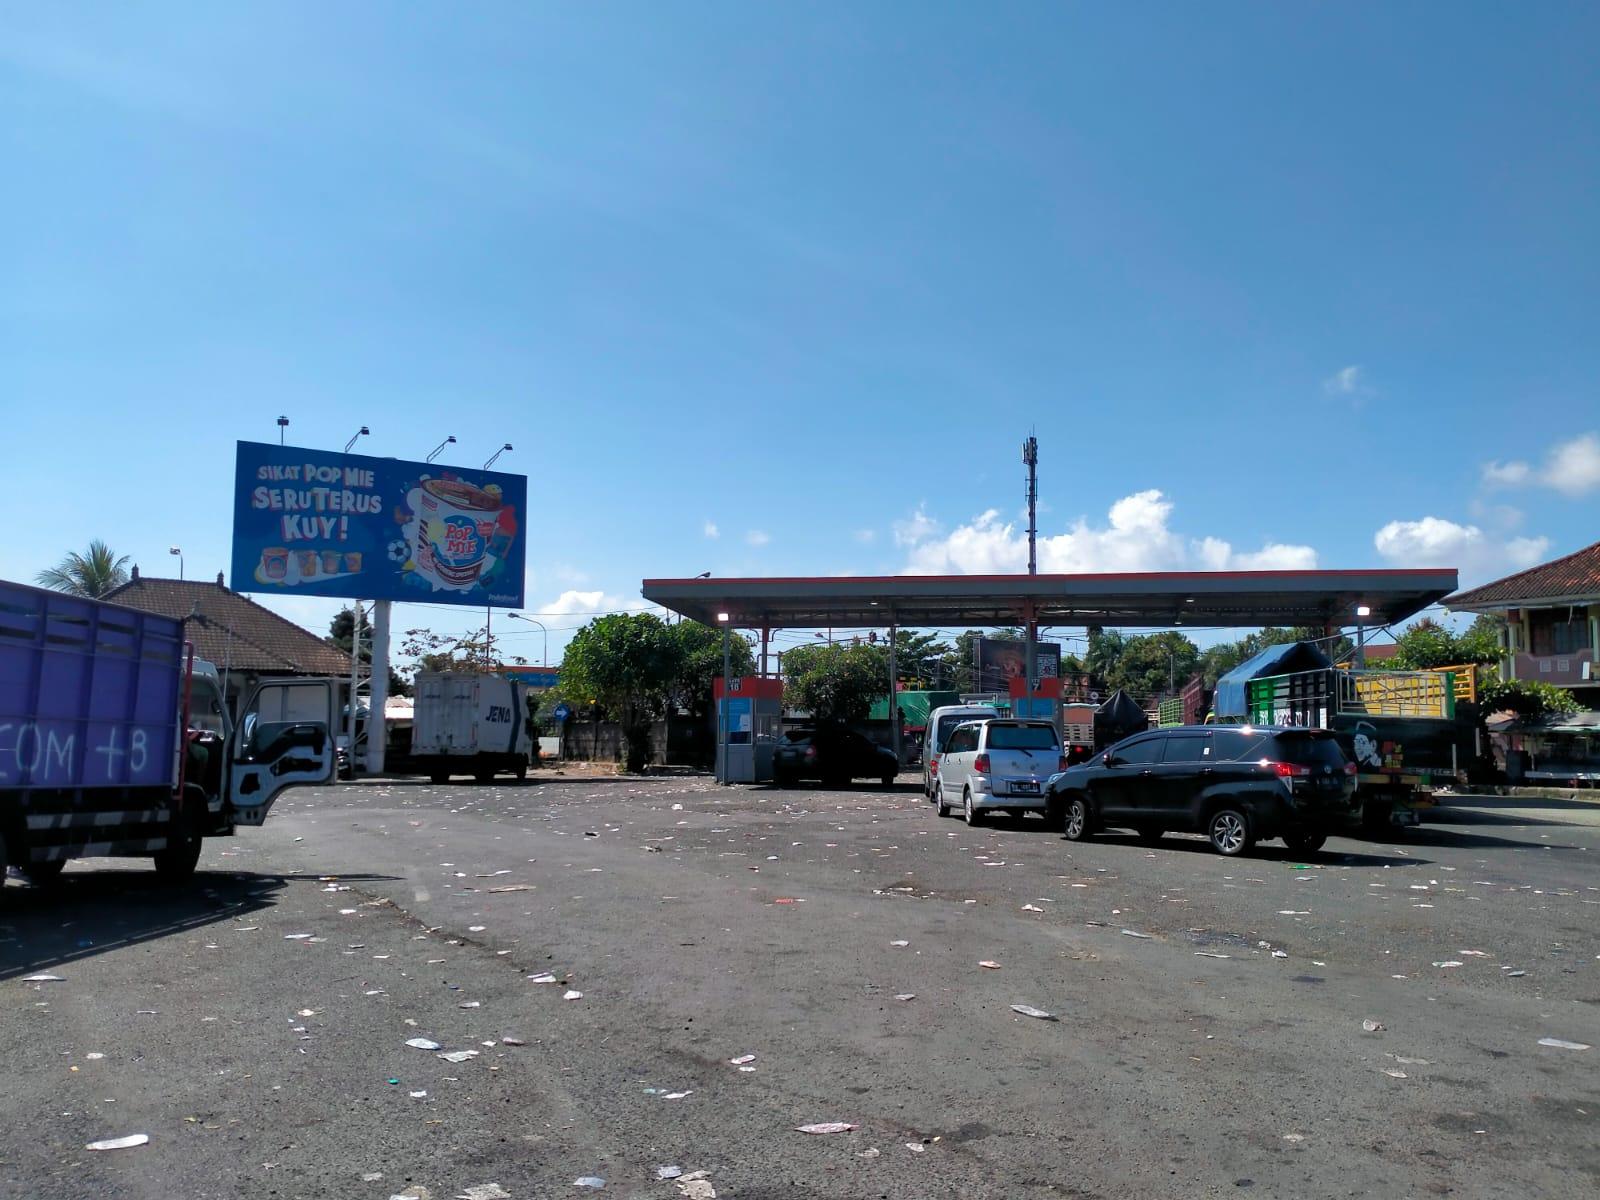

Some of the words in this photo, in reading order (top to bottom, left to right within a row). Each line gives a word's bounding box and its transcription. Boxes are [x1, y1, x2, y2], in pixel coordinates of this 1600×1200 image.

[258, 465, 301, 480] SIKAT
[304, 463, 342, 483] POP
[344, 467, 375, 487] MIE
[282, 514, 349, 542] KUY!
[444, 523, 475, 541] POP
[447, 540, 477, 553] MIE
